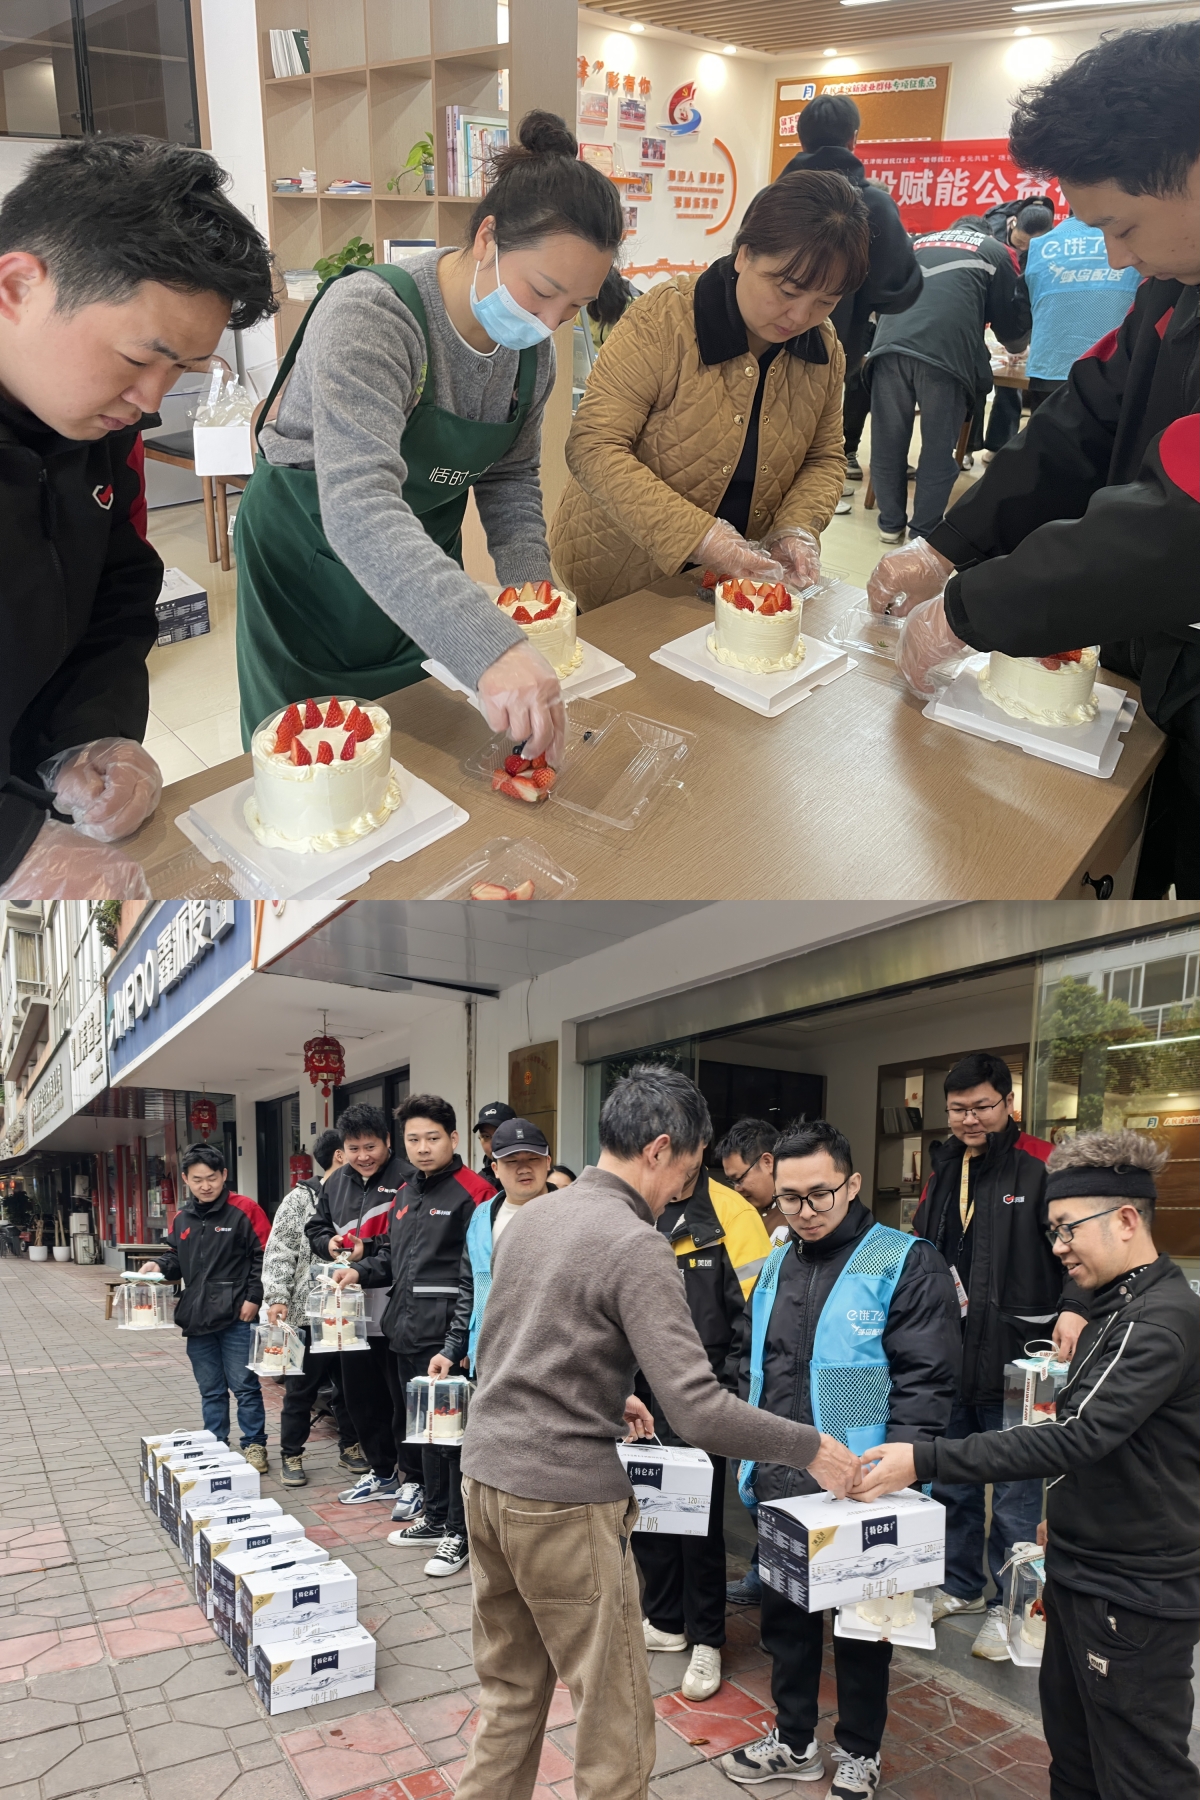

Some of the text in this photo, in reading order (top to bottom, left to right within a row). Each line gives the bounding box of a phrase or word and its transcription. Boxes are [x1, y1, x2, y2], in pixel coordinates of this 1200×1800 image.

[803, 85, 814, 98] 月
[697, 1259, 713, 1268] 美团
[862, 1577, 898, 1601] 纯牛奶
